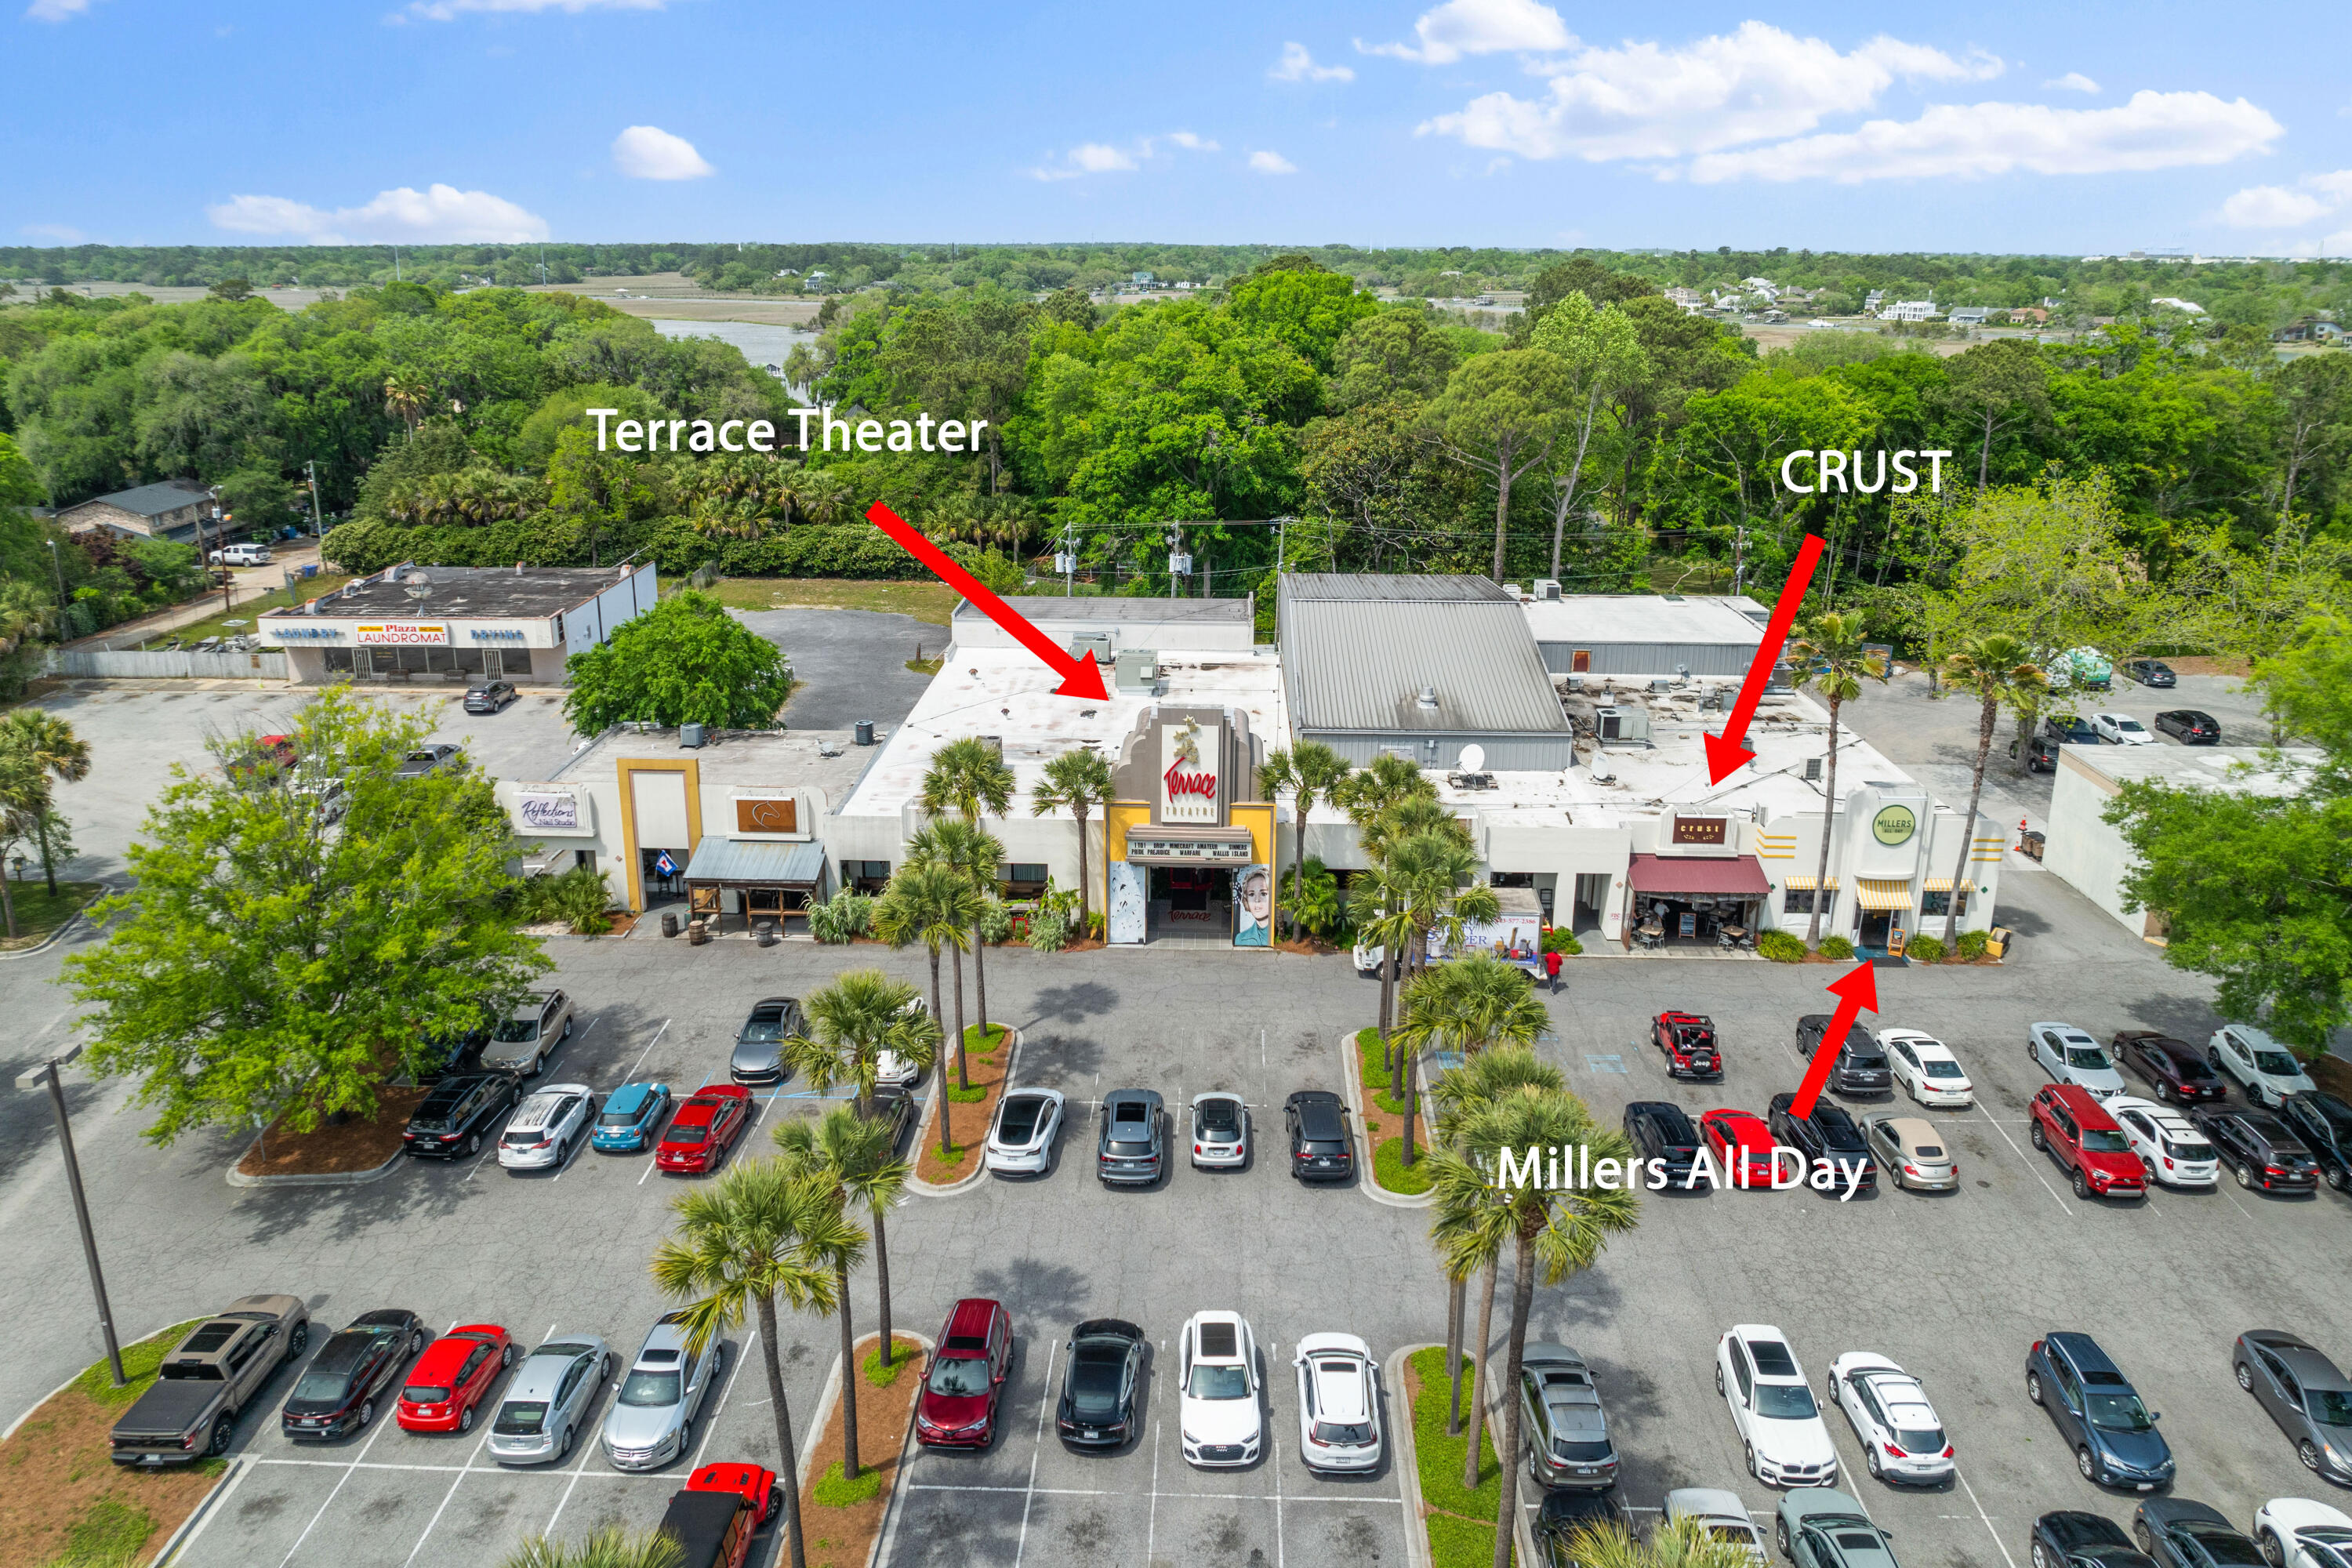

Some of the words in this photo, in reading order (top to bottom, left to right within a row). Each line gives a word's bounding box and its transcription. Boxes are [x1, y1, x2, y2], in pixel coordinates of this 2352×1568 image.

[275, 628, 337, 639] LAUNDRY
[385, 624, 418, 633] Plaza
[357, 633, 446, 643] LAUNDROMAT
[470, 630, 524, 640] DRYING
[1163, 756, 1216, 804] Terrace
[521, 800, 574, 825] Reflections
[1165, 806, 1215, 817] THEATRE
[1877, 819, 1911, 828] MILLERS
[1168, 909, 1211, 923] Terrace
